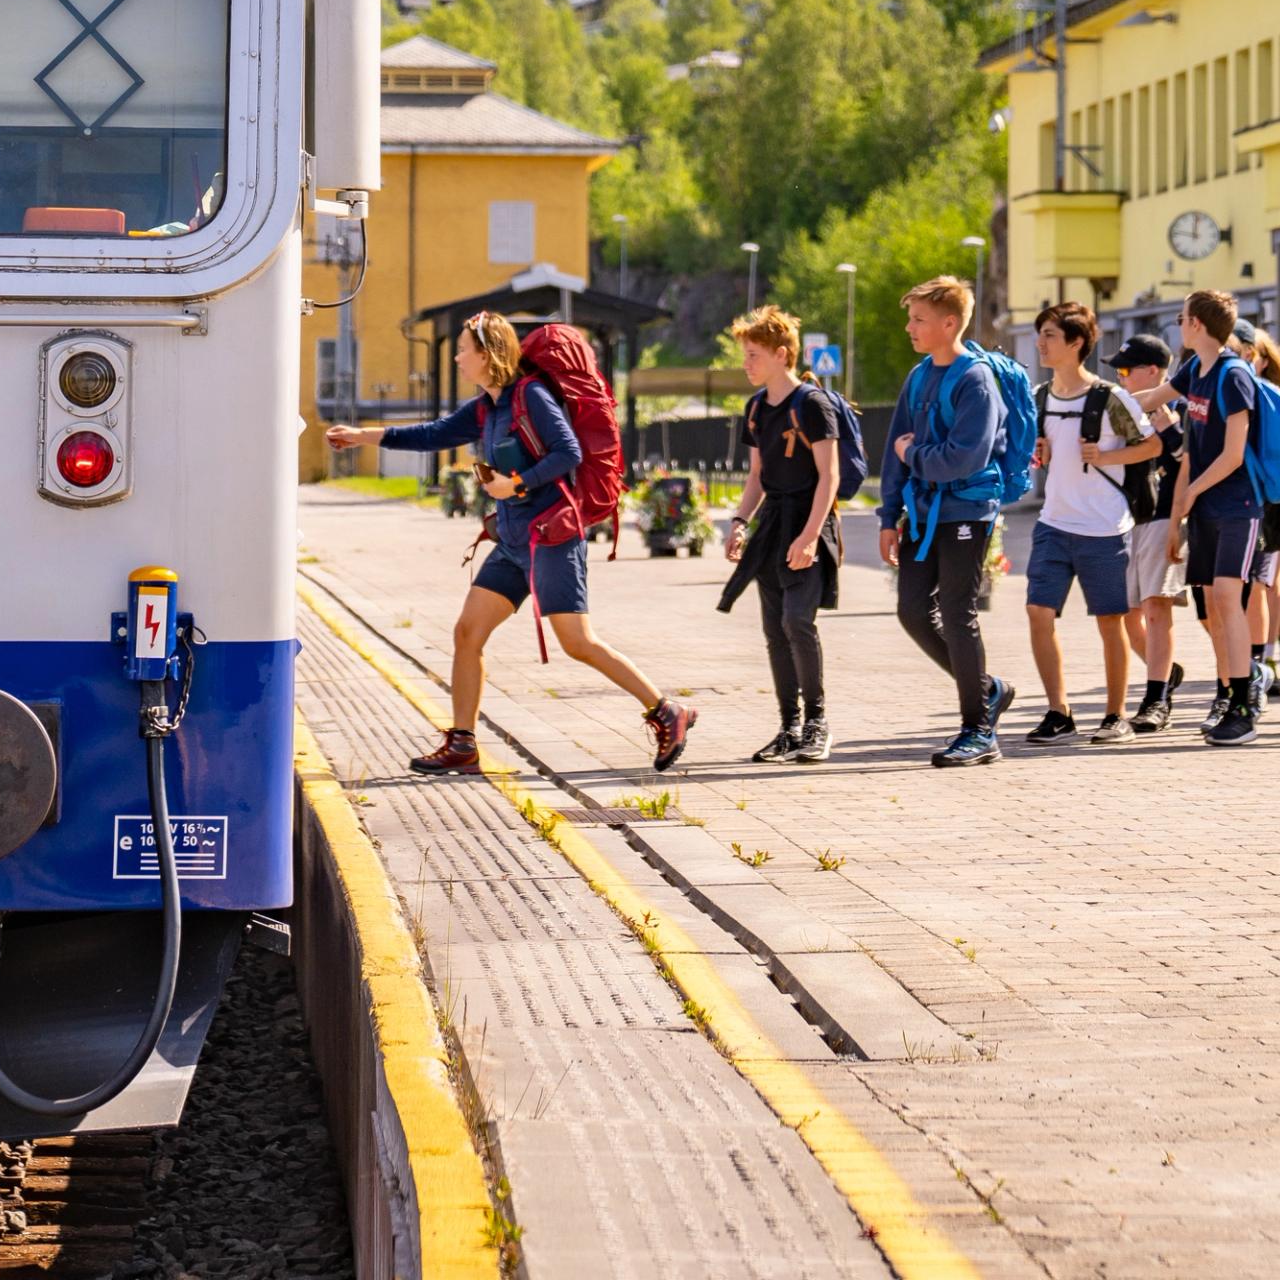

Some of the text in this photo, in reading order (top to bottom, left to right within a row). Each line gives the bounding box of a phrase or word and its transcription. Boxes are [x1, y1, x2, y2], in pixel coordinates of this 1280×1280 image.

[140, 823, 178, 834] 10V
[120, 835, 133, 850] e
[182, 836, 197, 846] 50
